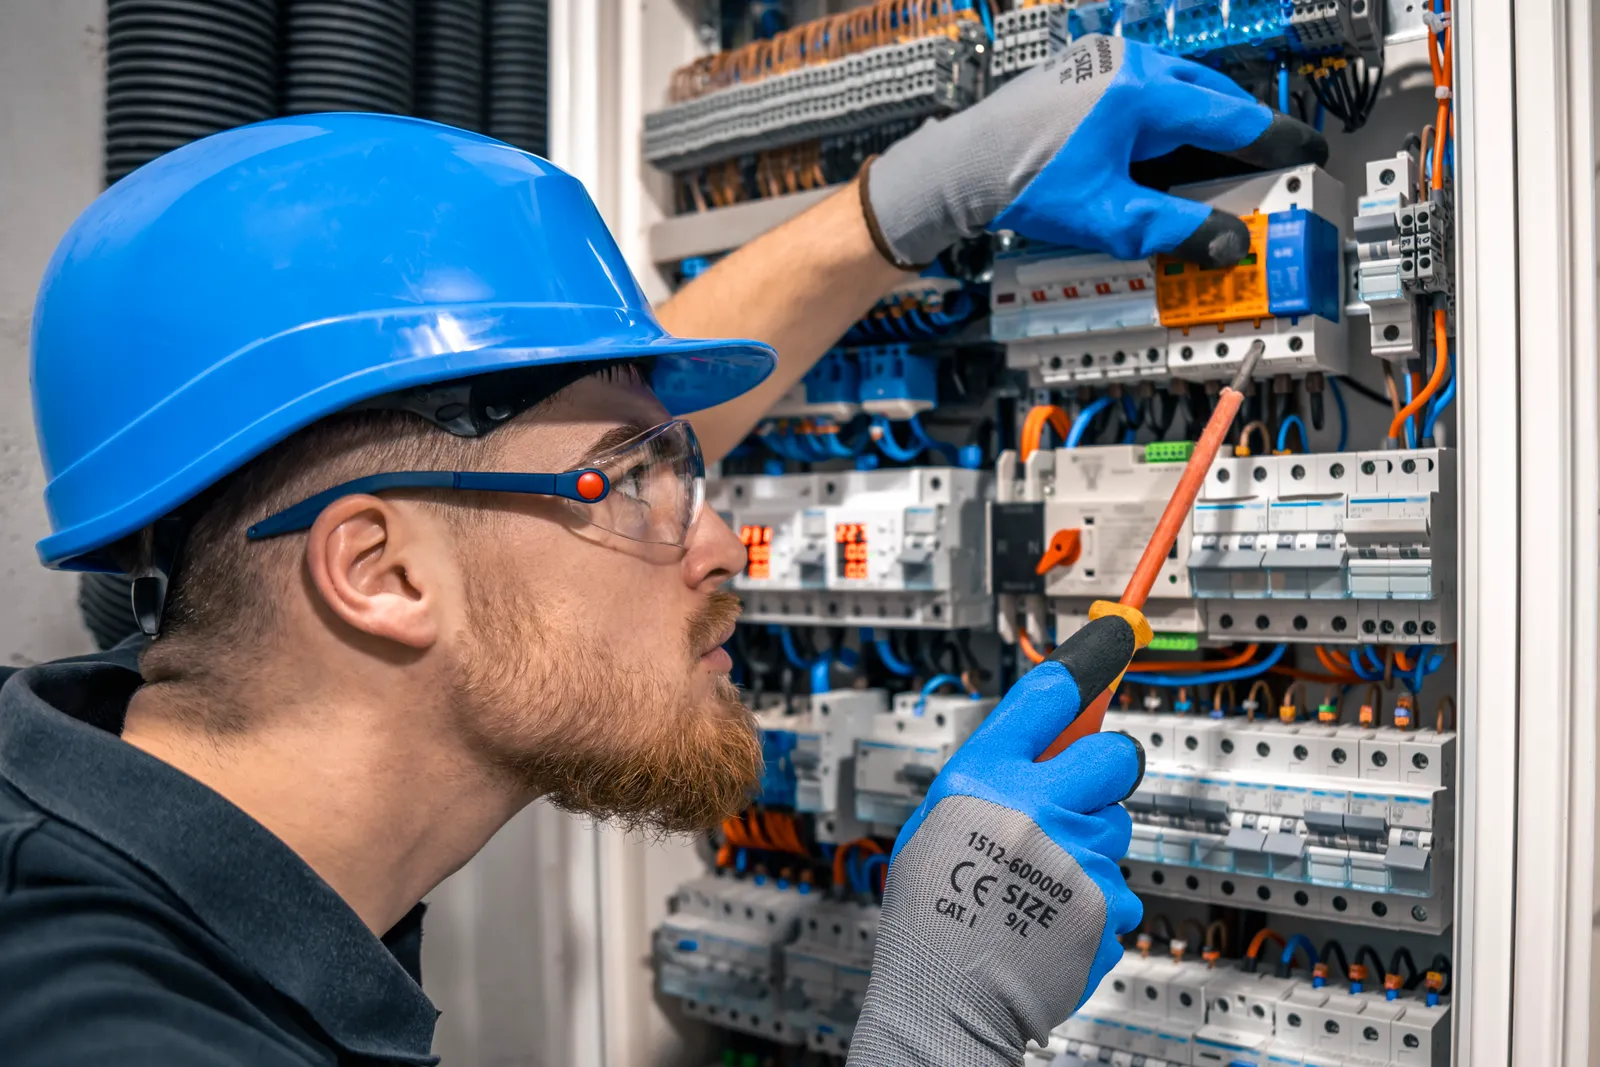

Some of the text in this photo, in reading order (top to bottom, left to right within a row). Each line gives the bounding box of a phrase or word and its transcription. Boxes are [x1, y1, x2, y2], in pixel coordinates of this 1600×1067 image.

[1073, 52, 1093, 84] SIZE
[950, 861, 998, 907] CE
[968, 831, 1073, 904] 1512-600009
[935, 898, 967, 923] CAT.
[1002, 884, 1058, 929] SIZE
[1005, 912, 1031, 938] 9/L
